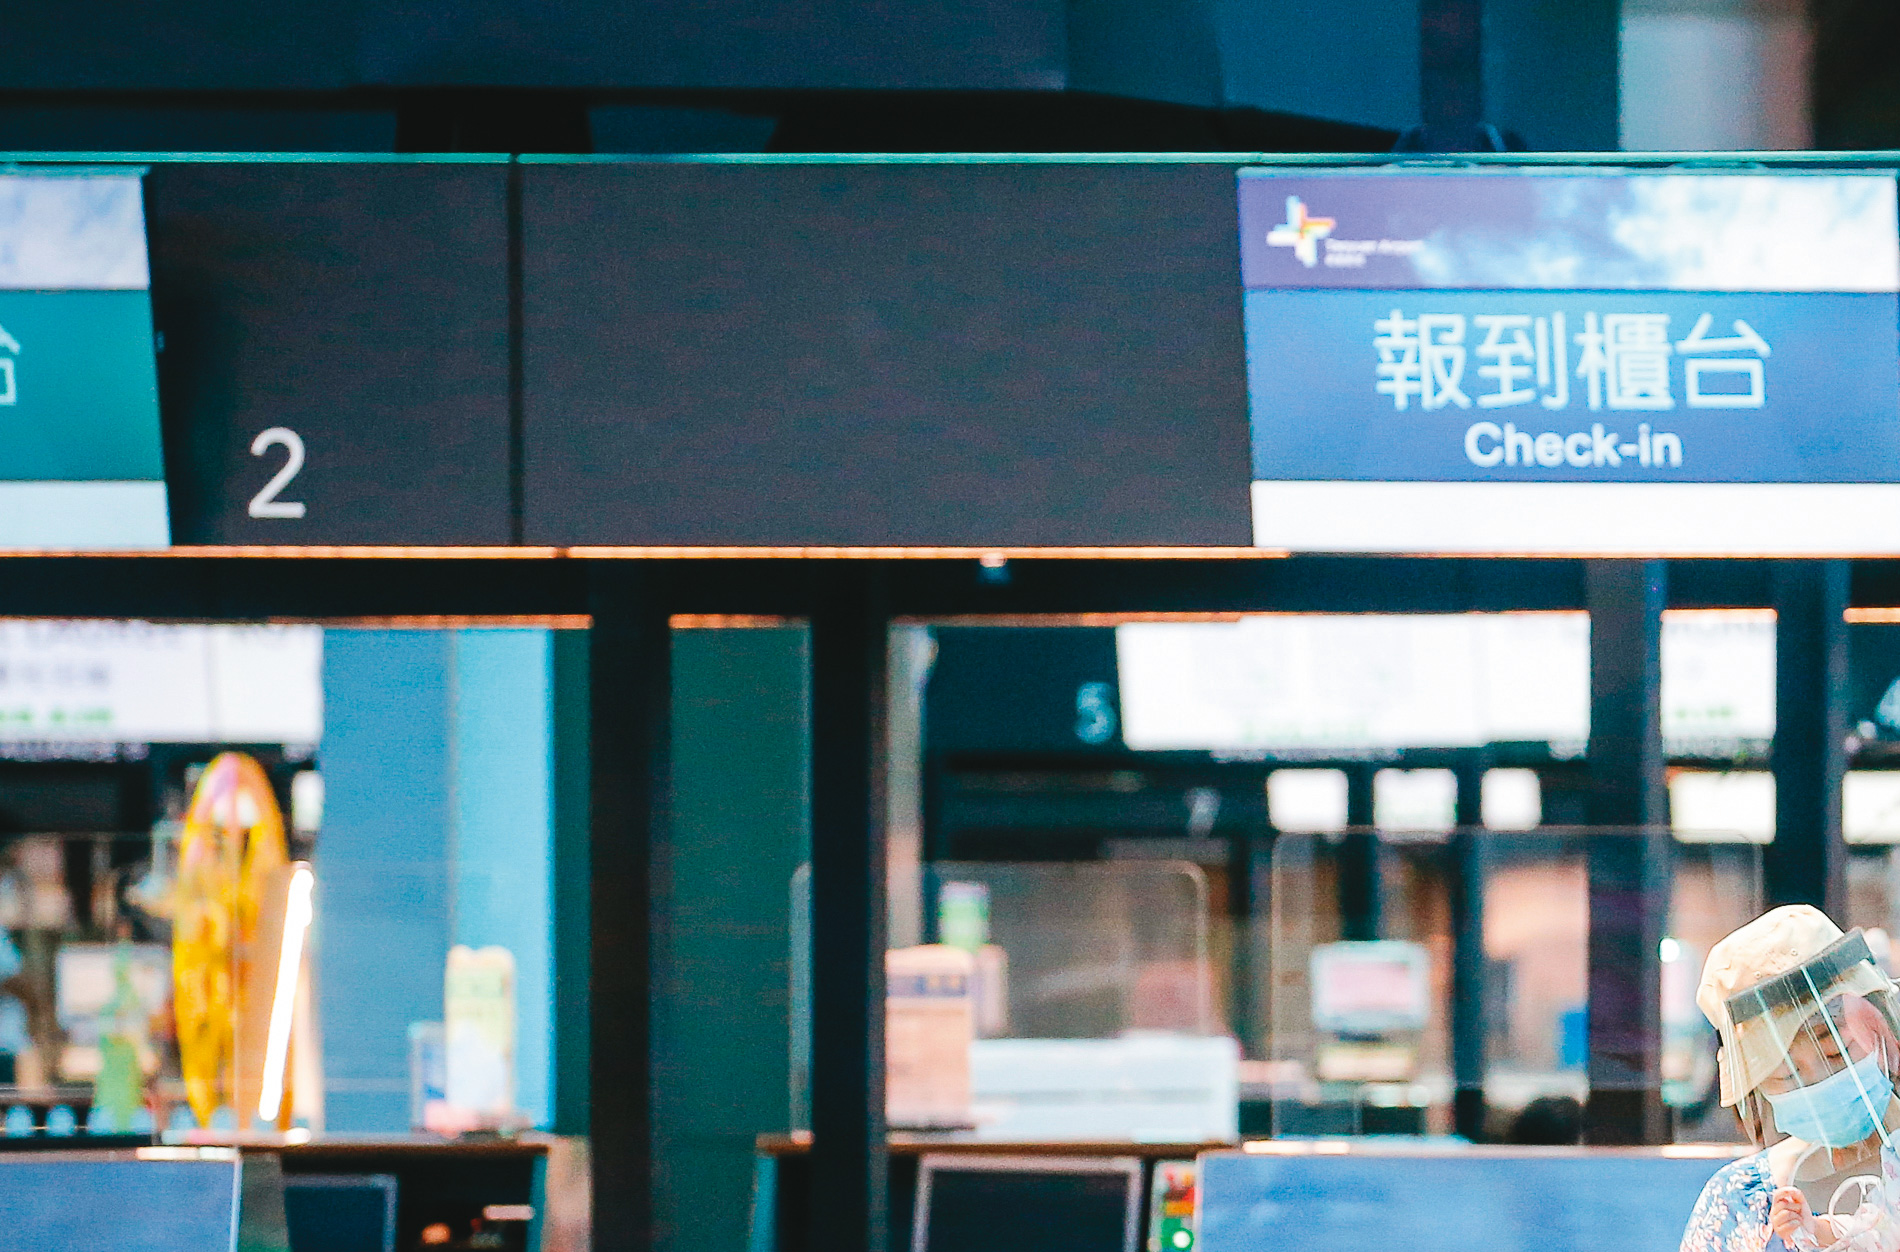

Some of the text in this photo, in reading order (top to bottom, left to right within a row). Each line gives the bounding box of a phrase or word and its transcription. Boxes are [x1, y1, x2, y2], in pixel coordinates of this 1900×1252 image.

[1373, 309, 1772, 411] 報到櫃台
[248, 427, 306, 519] 2
[1464, 421, 1683, 467] Check-in
